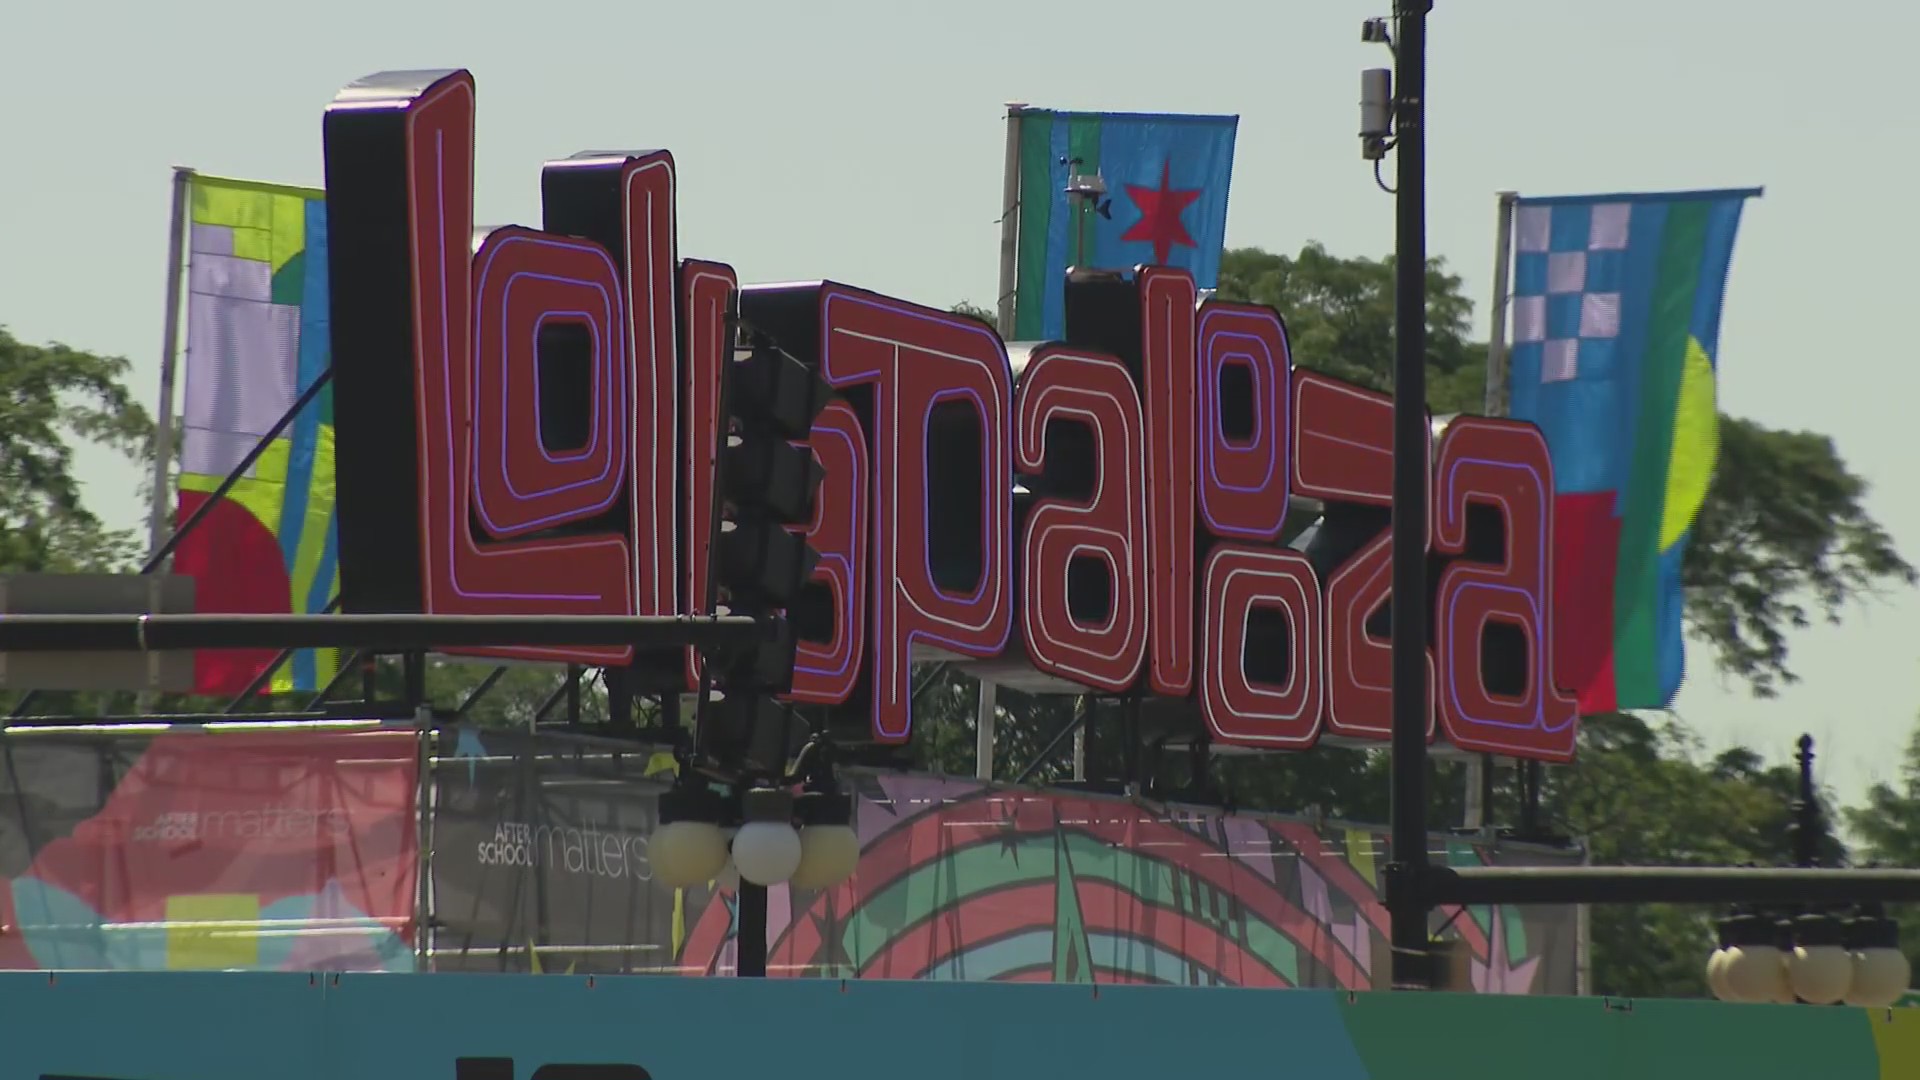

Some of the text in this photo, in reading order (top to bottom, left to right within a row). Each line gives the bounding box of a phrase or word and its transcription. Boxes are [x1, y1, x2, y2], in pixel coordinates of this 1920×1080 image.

[203, 803, 350, 838] matters
[495, 821, 533, 844] AFTER
[477, 841, 534, 867] SCHOOL
[534, 818, 654, 881] matters
